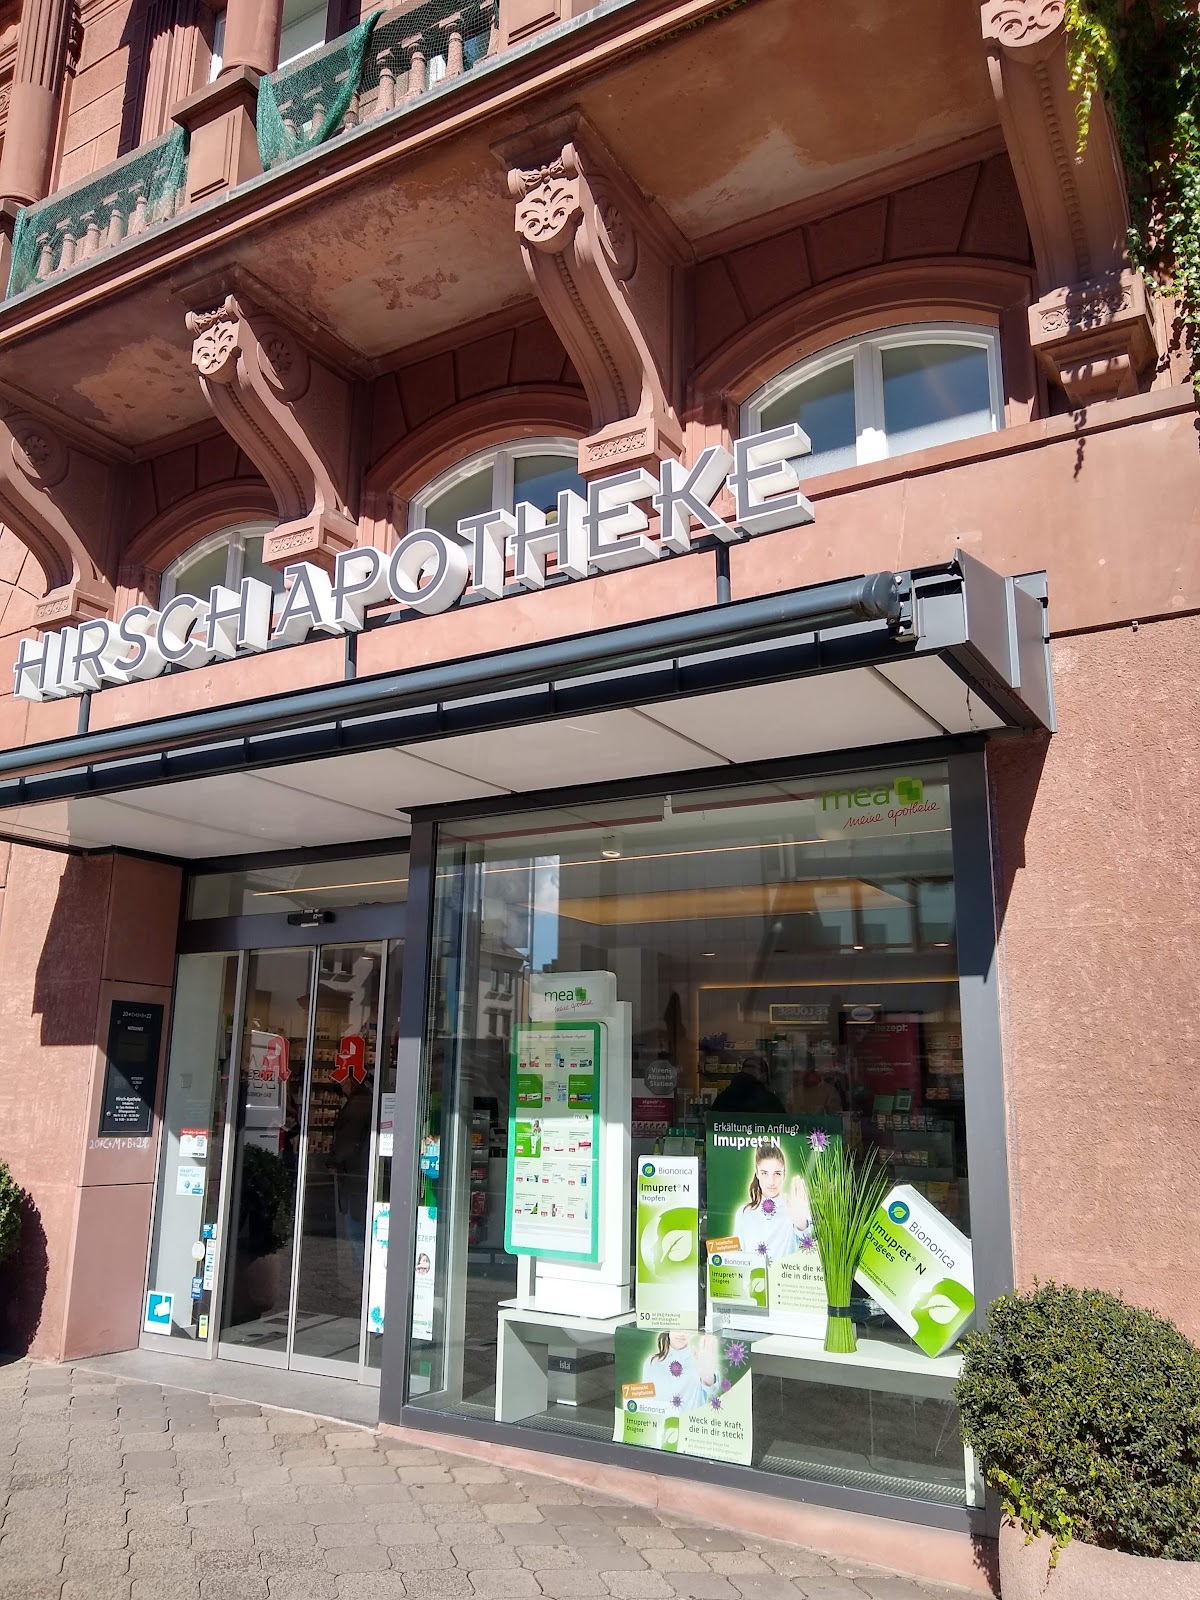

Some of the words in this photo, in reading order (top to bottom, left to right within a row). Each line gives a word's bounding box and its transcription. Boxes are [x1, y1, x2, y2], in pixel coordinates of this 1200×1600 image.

[13, 577, 270, 702] HIRSCH
[273, 421, 816, 641] APOTHEKE
[821, 784, 890, 810] mea
[544, 990, 574, 1002] mea
[714, 1122, 752, 1134] Erkältung
[754, 1123, 766, 1132] im
[767, 1124, 800, 1136] Anflug?
[770, 1136, 780, 1148] N
[708, 1242, 715, 1252] 7
[866, 1232, 895, 1262] Dragees
[908, 1222, 955, 1269] Bionorica
[781, 1263, 800, 1271] Weck
[915, 1262, 926, 1275] N
[559, 1360, 571, 1370] isla
[624, 1386, 630, 1397] 7
[640, 1404, 666, 1414] Bionorica
[688, 1416, 708, 1425] Weck
[710, 1418, 721, 1426] die
[724, 1420, 744, 1431] Kraft,
[689, 1425, 699, 1433] die
[722, 1430, 744, 1440] steckt
